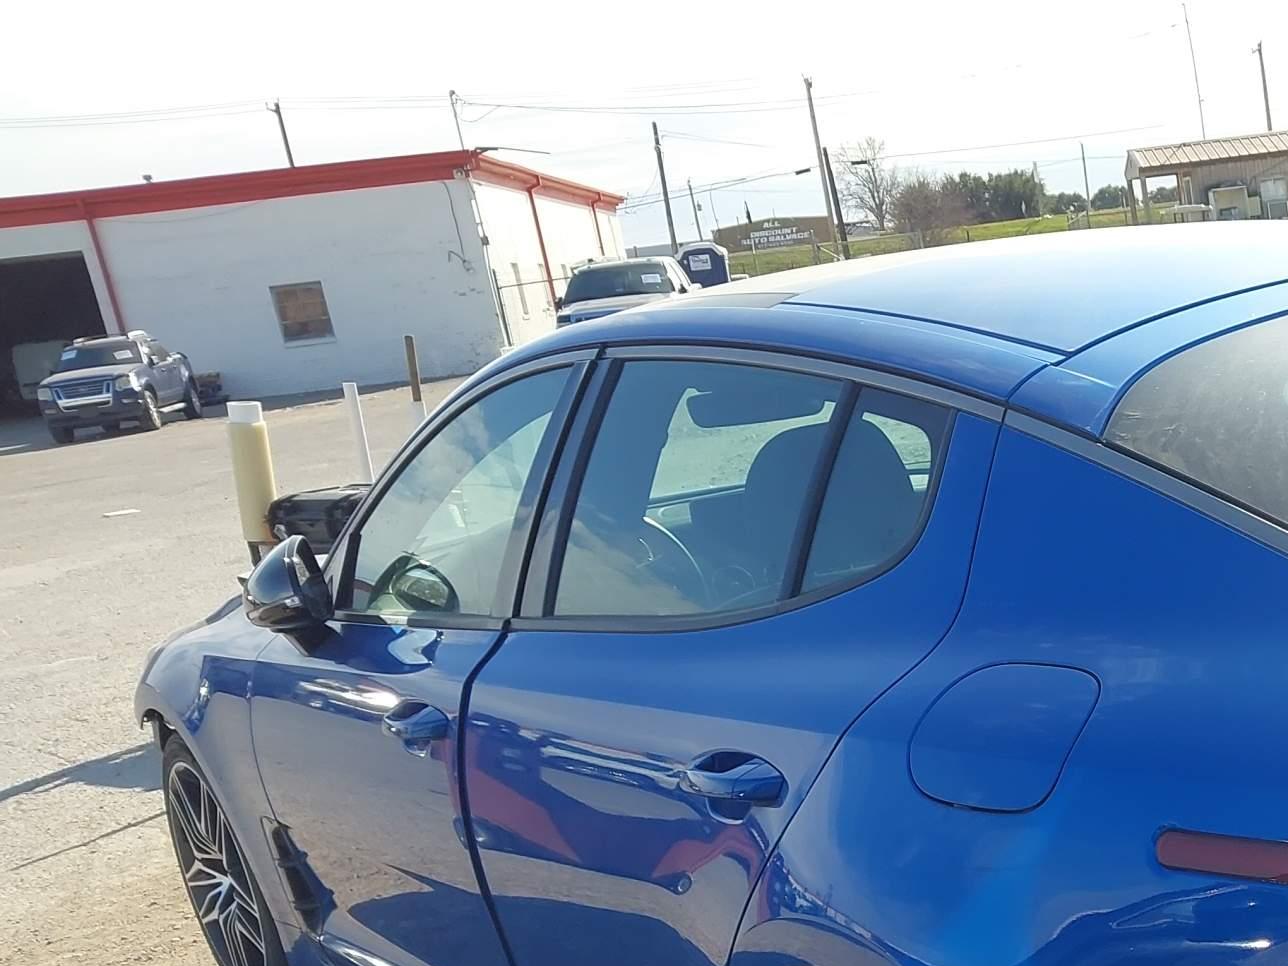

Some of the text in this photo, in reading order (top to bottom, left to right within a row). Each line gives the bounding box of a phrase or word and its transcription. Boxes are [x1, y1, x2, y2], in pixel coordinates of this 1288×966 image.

[763, 220, 781, 228] ALL
[741, 237, 767, 245] AUTO
[769, 231, 809, 241] SALVAGE
[751, 227, 797, 238] DISCOUNT
